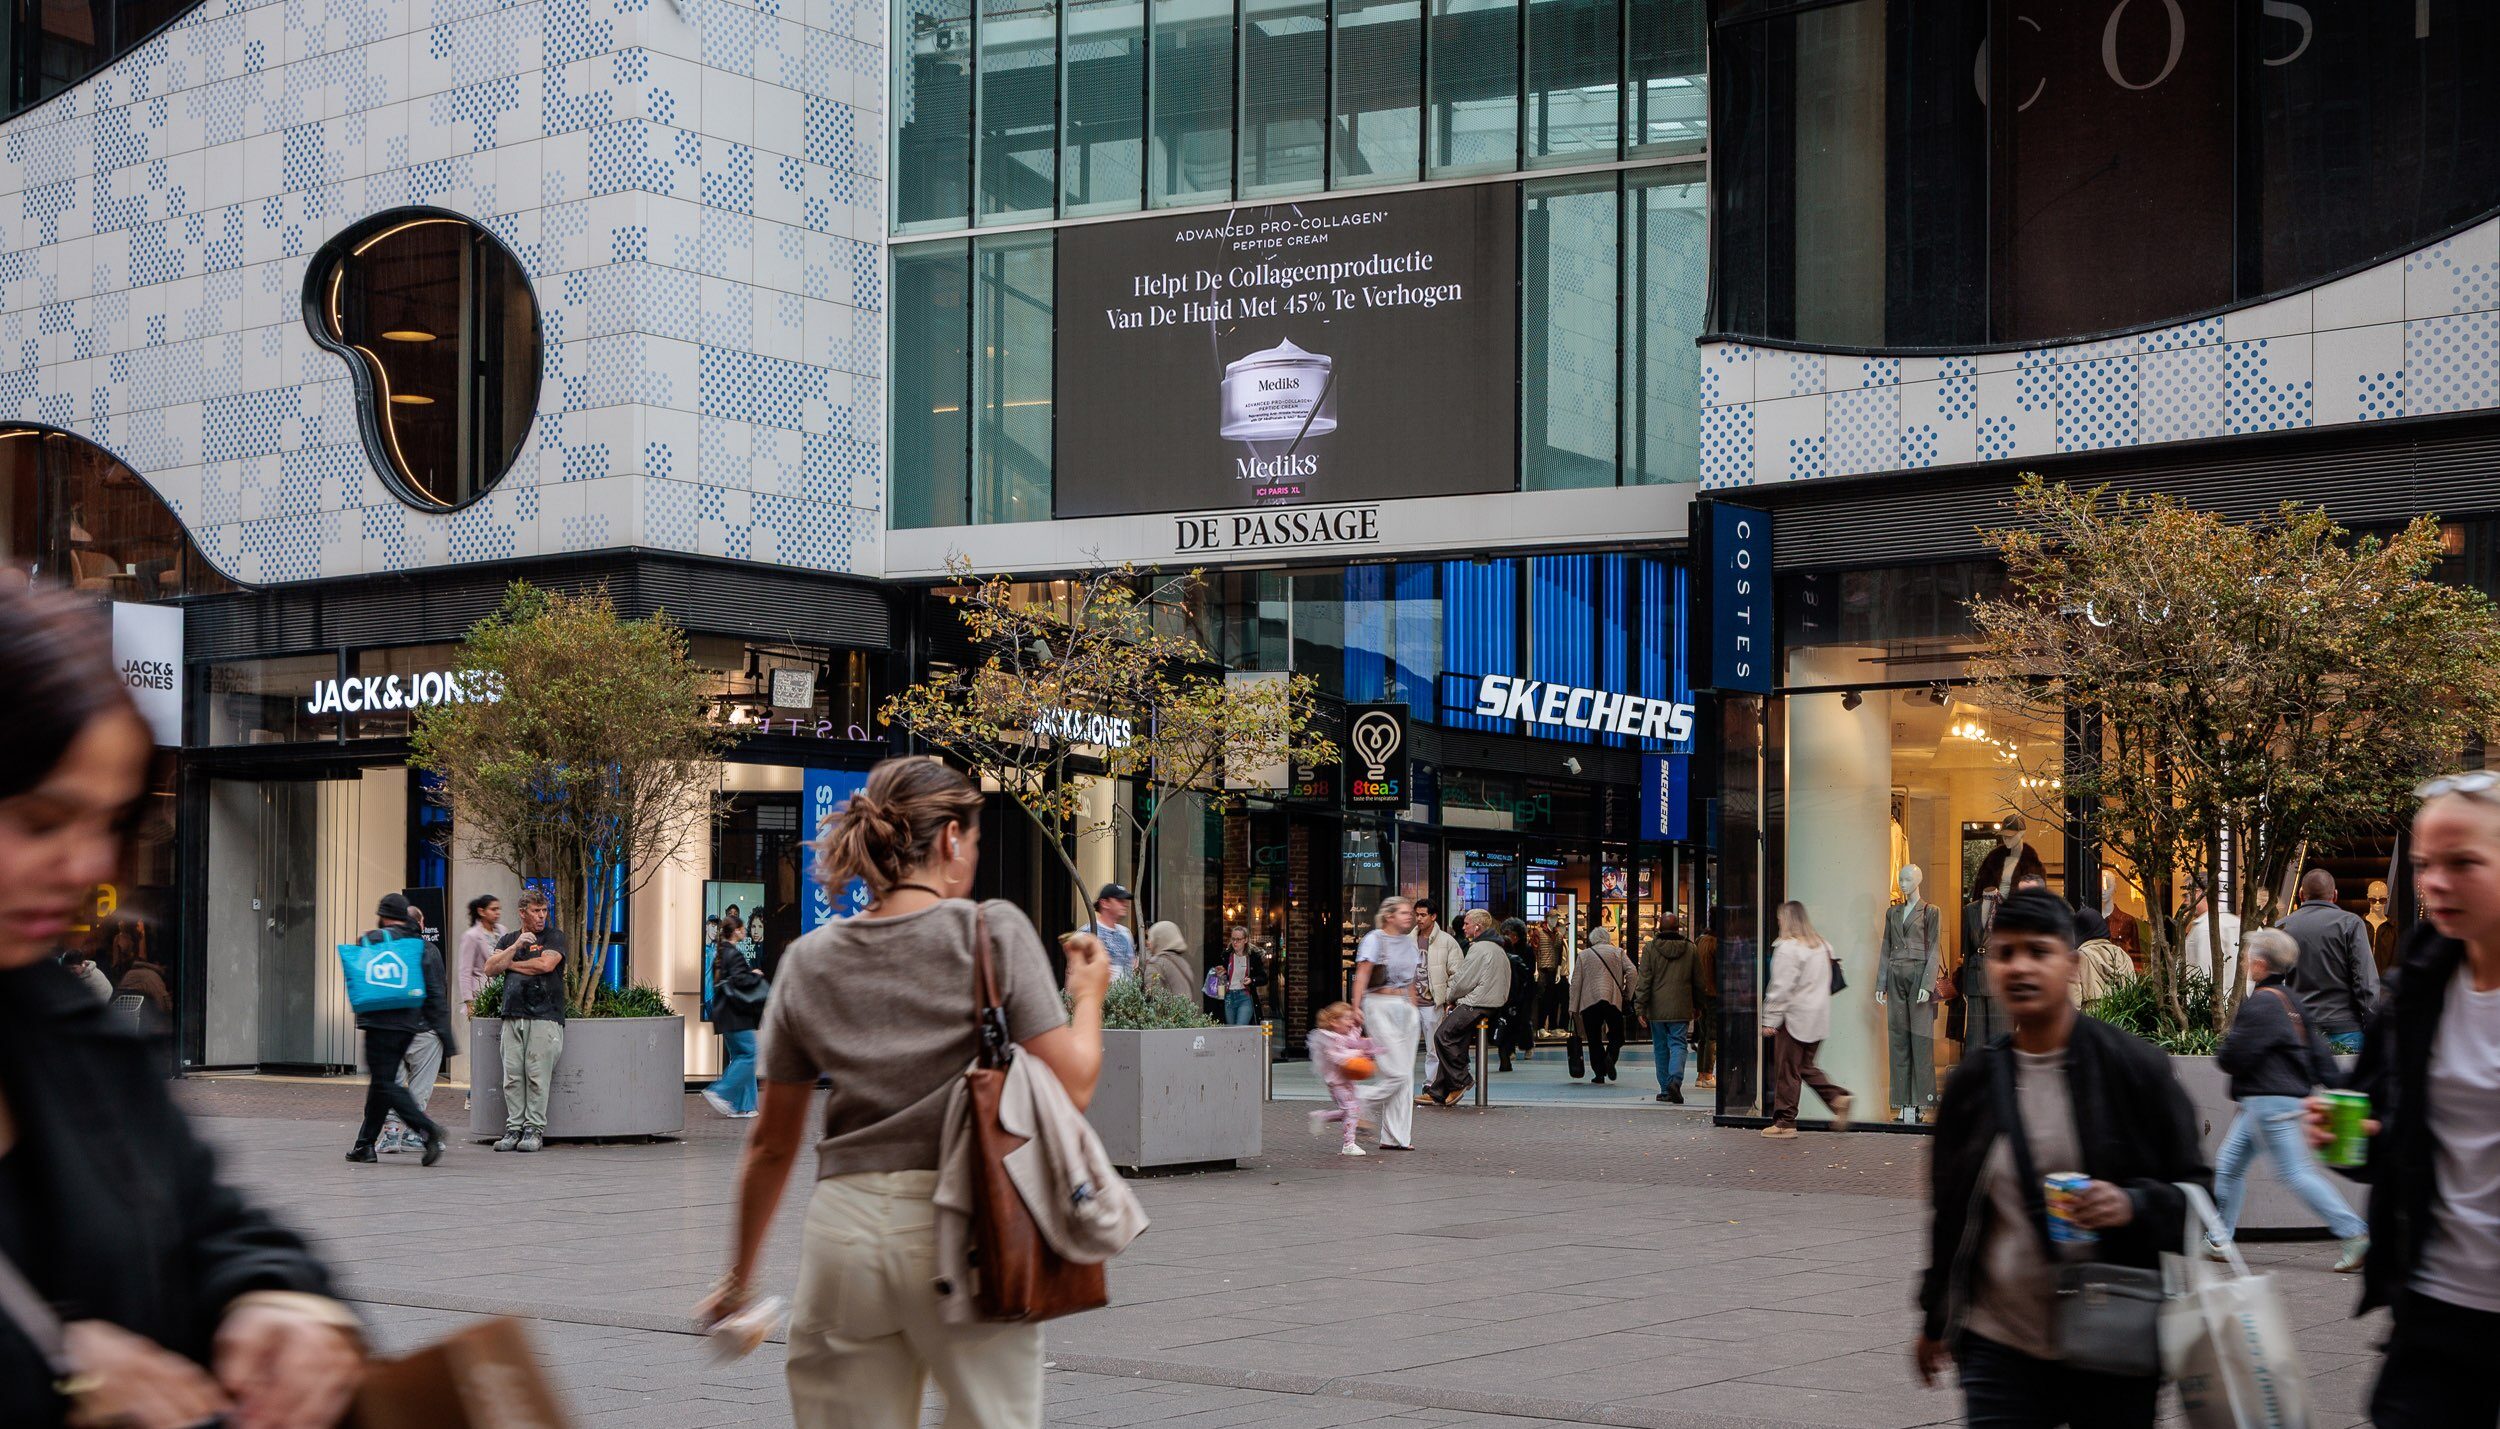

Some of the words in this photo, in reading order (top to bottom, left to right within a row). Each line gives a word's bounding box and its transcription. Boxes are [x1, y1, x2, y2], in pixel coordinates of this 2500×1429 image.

[1175, 224, 1254, 242] ADVANCED
[1233, 238, 1283, 251] PEPTIDE
[1287, 234, 1328, 247] CREAM
[1134, 273, 1189, 300] Helpt
[1195, 269, 1223, 291] De
[1229, 250, 1433, 288] Collageenproductie
[1106, 308, 1143, 330] Van
[1150, 304, 1177, 326] De
[1183, 298, 1233, 323] Huid
[1239, 297, 1278, 319] Met
[1283, 291, 1326, 314] 45%
[1332, 289, 1355, 311] Te
[1362, 281, 1463, 308] Verhogen
[1258, 378, 1300, 392] Medik8
[1236, 454, 1317, 479] Medik8
[1256, 488, 1267, 496] ICI
[1268, 487, 1288, 495] PARIS
[1291, 486, 1300, 494] XL
[1176, 518, 1220, 550] DE
[1232, 509, 1379, 546] PASSAGE
[1737, 521, 1750, 677] COSTES
[122, 659, 173, 676] JACK&
[122, 674, 173, 690] JONES
[1476, 674, 1695, 742] SKECHERS
[1353, 780, 1399, 795] 8tea5
[1660, 759, 1669, 835] SKECHERS
